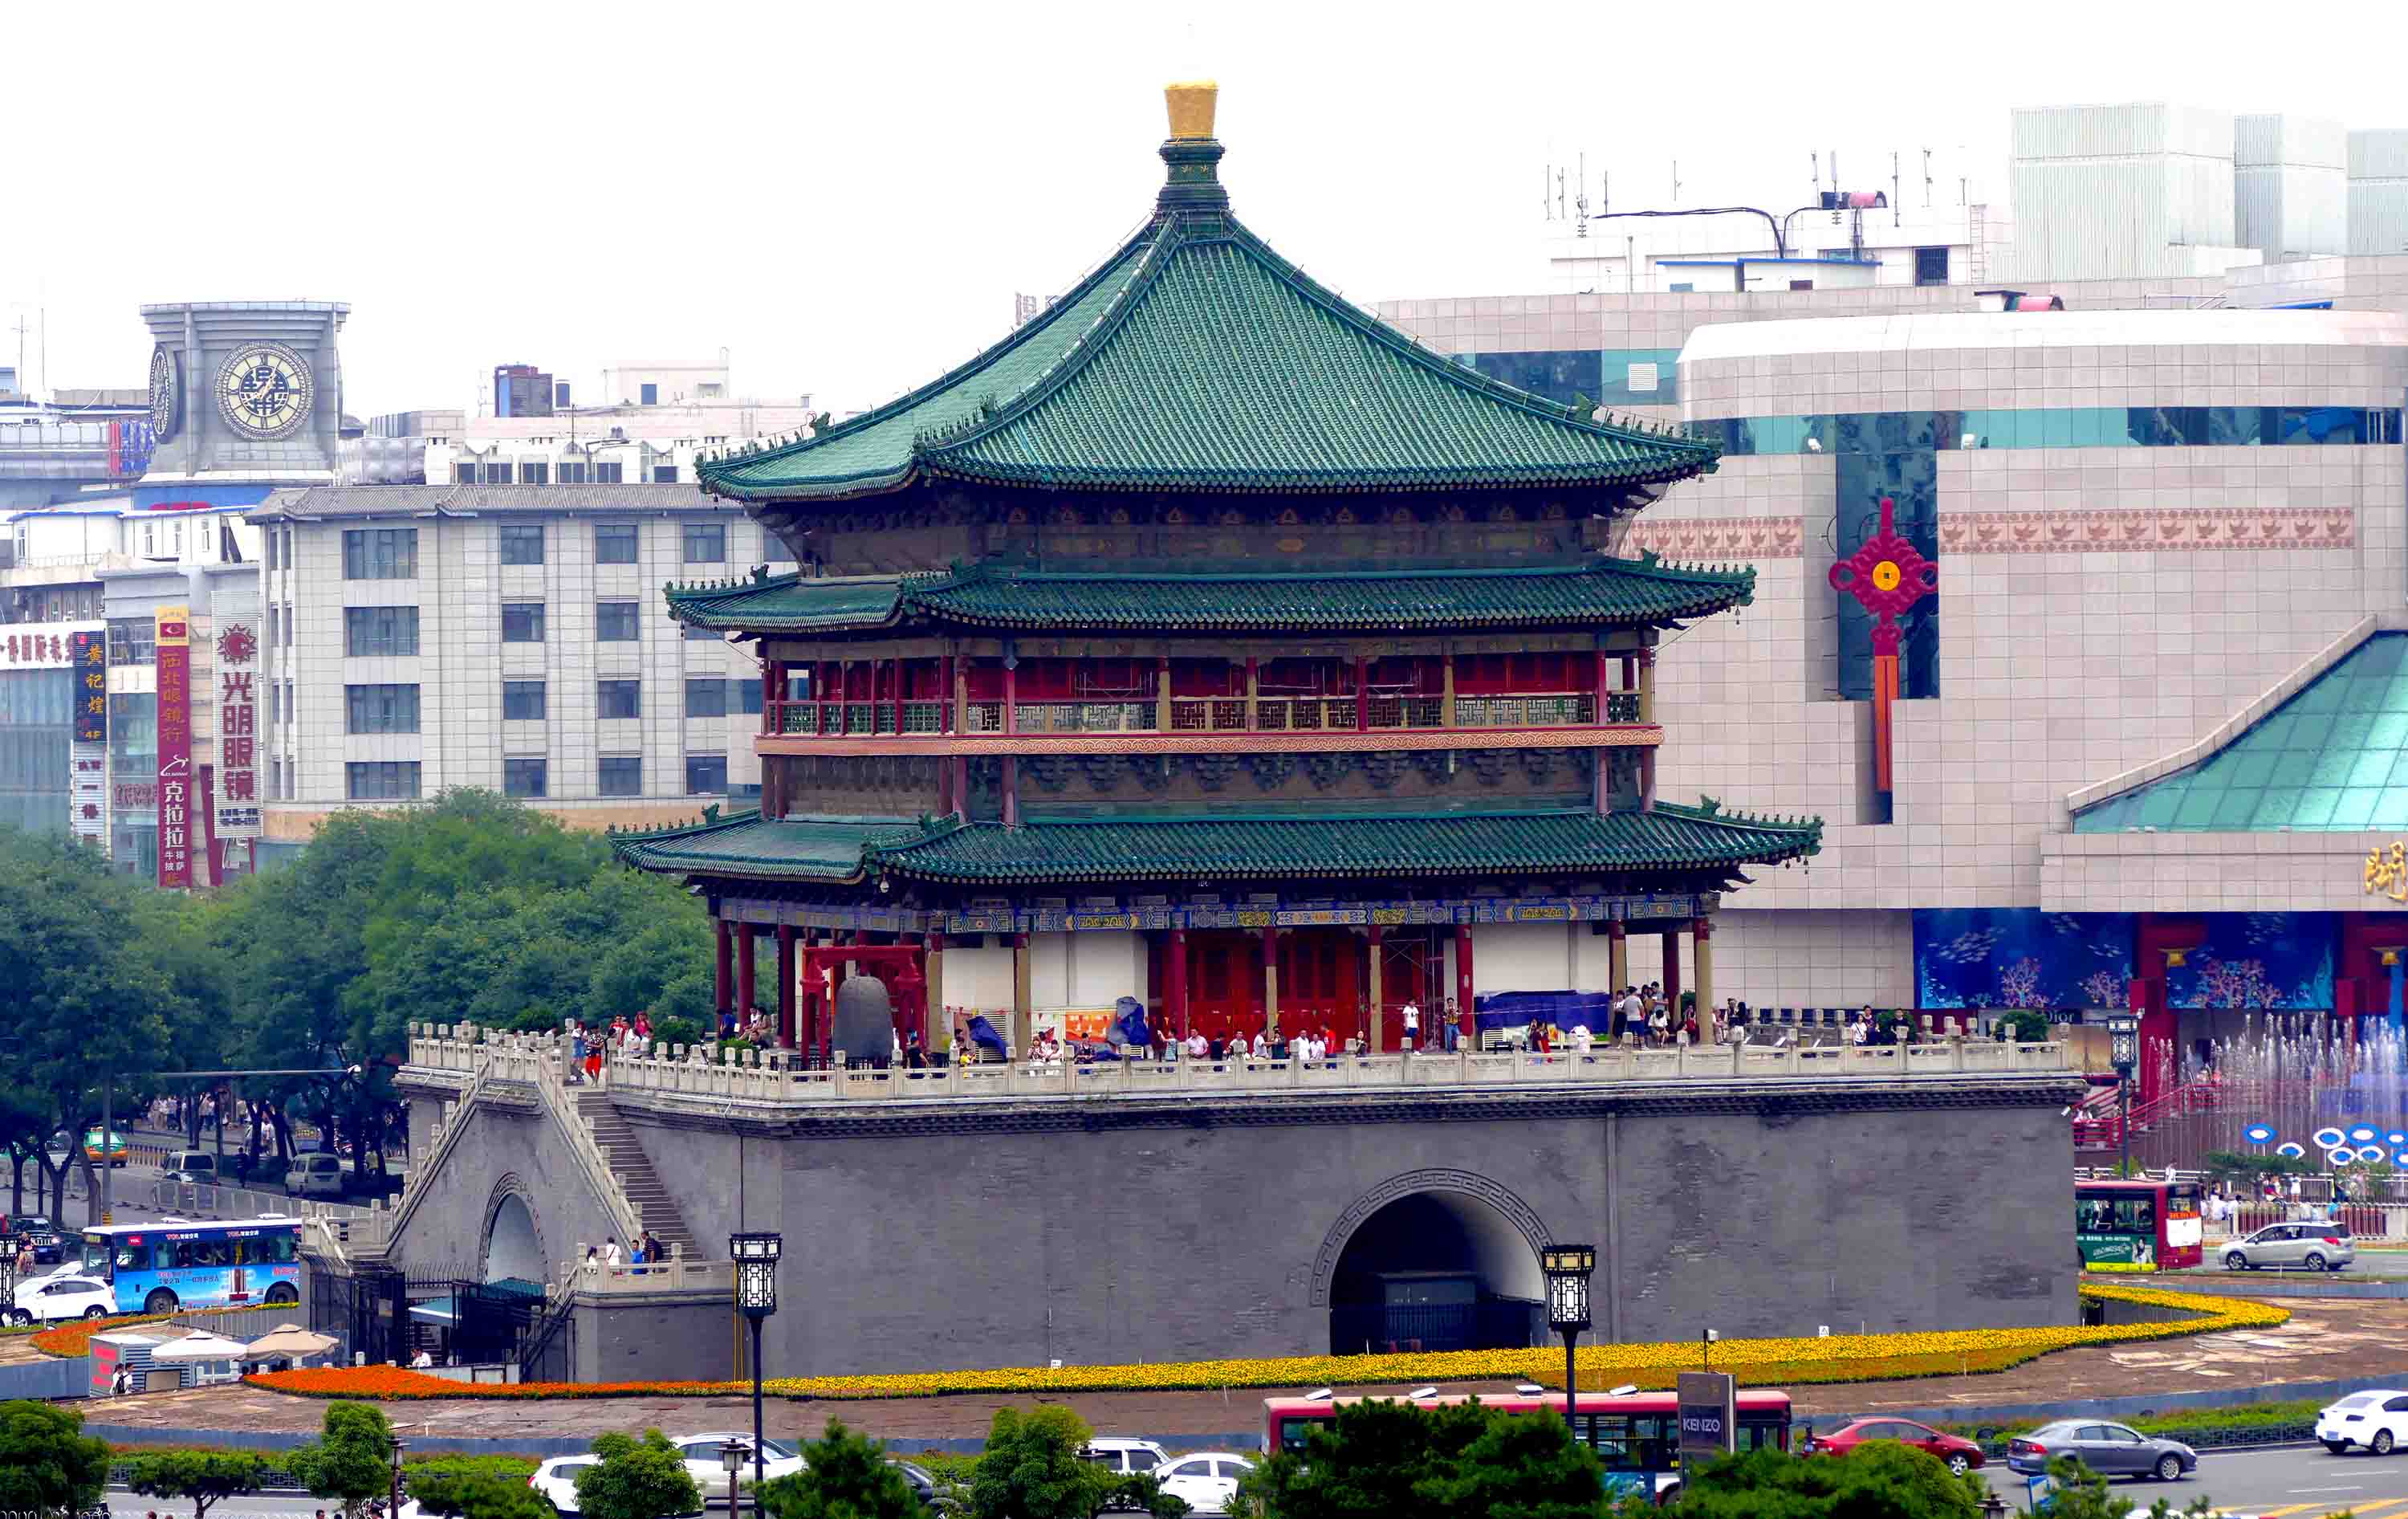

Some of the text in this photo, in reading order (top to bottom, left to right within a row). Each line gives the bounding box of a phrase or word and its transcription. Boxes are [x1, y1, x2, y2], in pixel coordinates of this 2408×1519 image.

[222, 672, 254, 801] 光明眼镜
[165, 780, 185, 849] 克拉拉
[1682, 1417, 1720, 1432] KENZO
